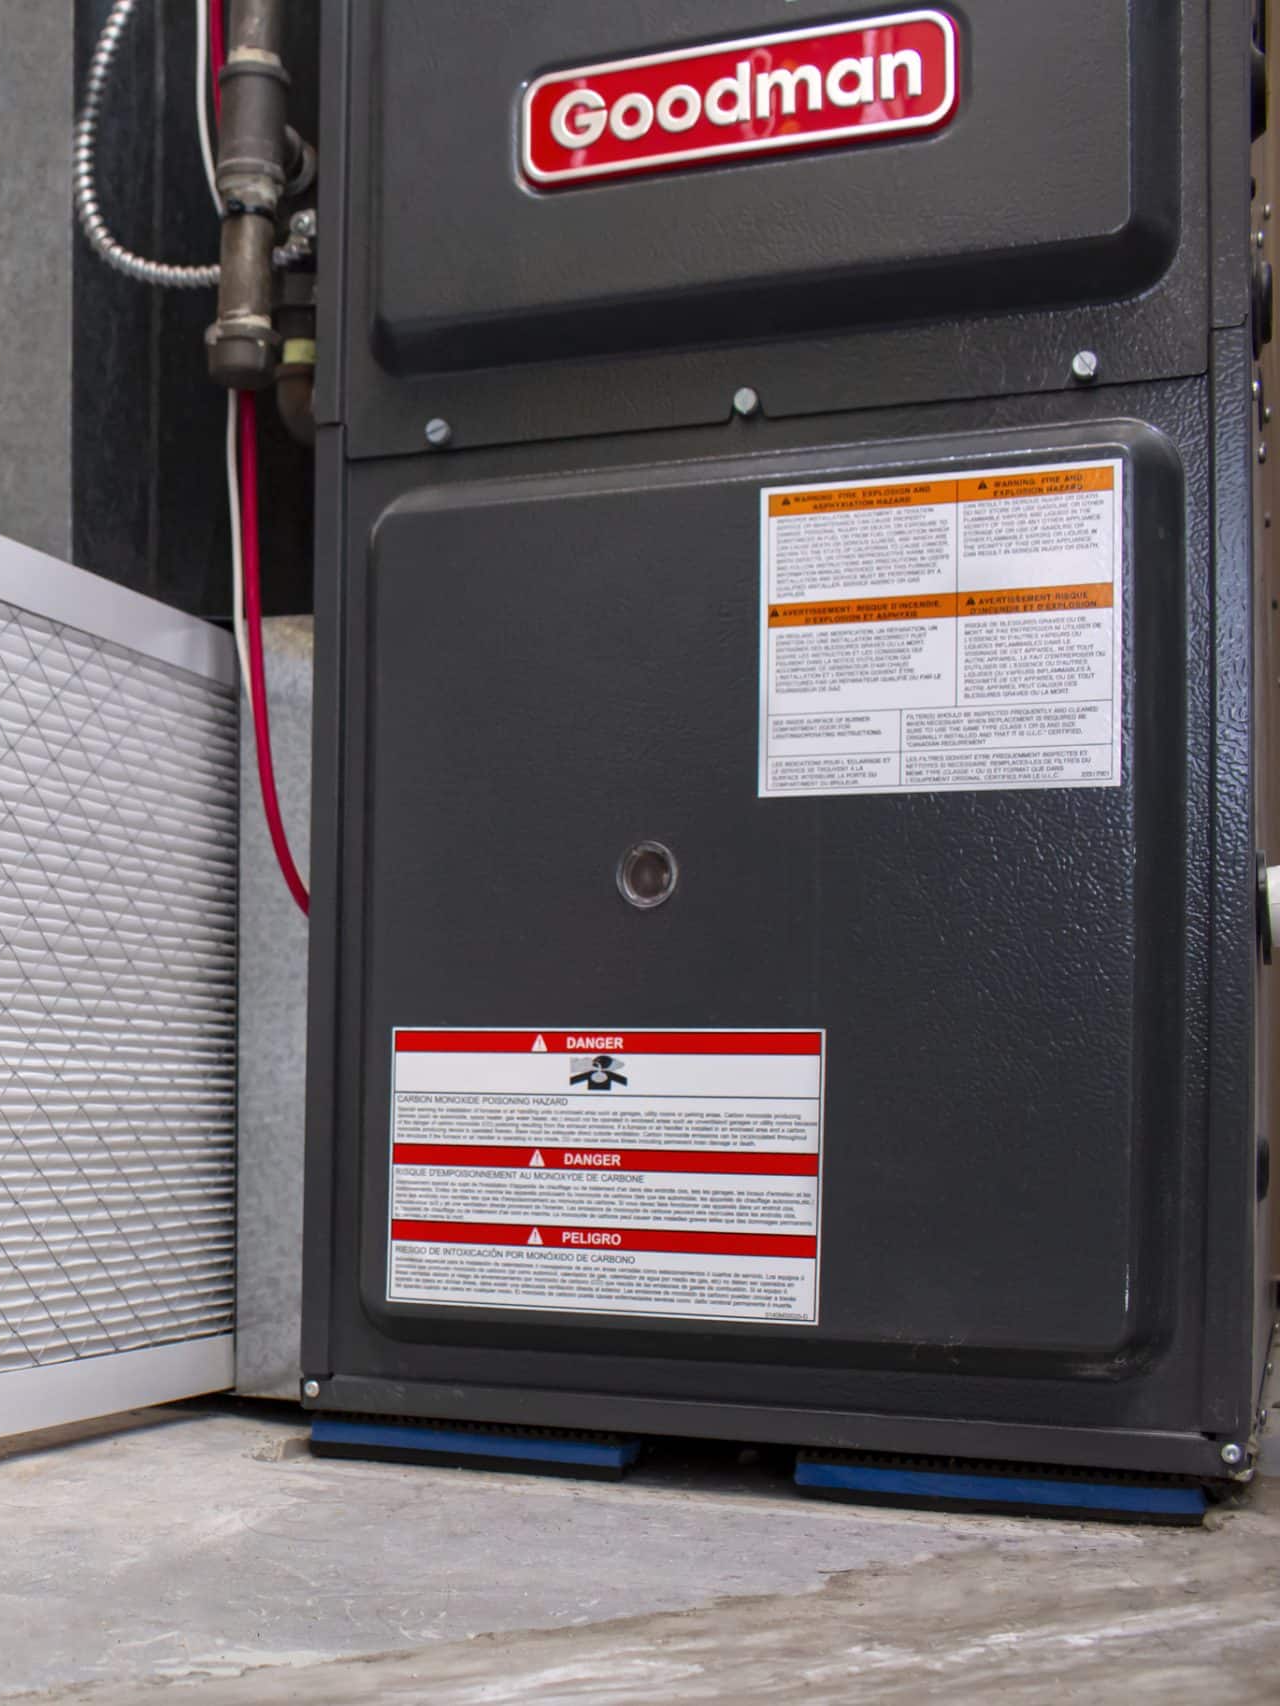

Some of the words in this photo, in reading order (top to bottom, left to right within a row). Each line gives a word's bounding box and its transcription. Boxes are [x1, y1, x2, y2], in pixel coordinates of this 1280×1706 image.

[549, 48, 923, 149] Goodman
[565, 1036, 624, 1049] DANGER
[397, 1094, 432, 1104] CARBON
[434, 1095, 480, 1104] MONOXIDE
[482, 1096, 530, 1106] POISONING
[532, 1097, 569, 1106] HAZARD
[563, 1152, 622, 1167] DANGER
[395, 1167, 427, 1177] RISQUE
[429, 1168, 517, 1180] D'EMPOISONNEMENT
[519, 1171, 531, 1181] AU
[533, 1172, 584, 1182] MONOXYDE
[586, 1173, 599, 1183] DE
[601, 1174, 644, 1184] CARBONE
[561, 1231, 622, 1246] PELIGRO
[395, 1244, 427, 1255] RIESGO
[429, 1246, 441, 1256] DE
[443, 1246, 503, 1259] INTOXICACIÓN
[505, 1249, 524, 1260] POR
[526, 1250, 574, 1263] MONÓXIDO
[576, 1252, 589, 1263] DE
[591, 1253, 636, 1266] CARBONO
